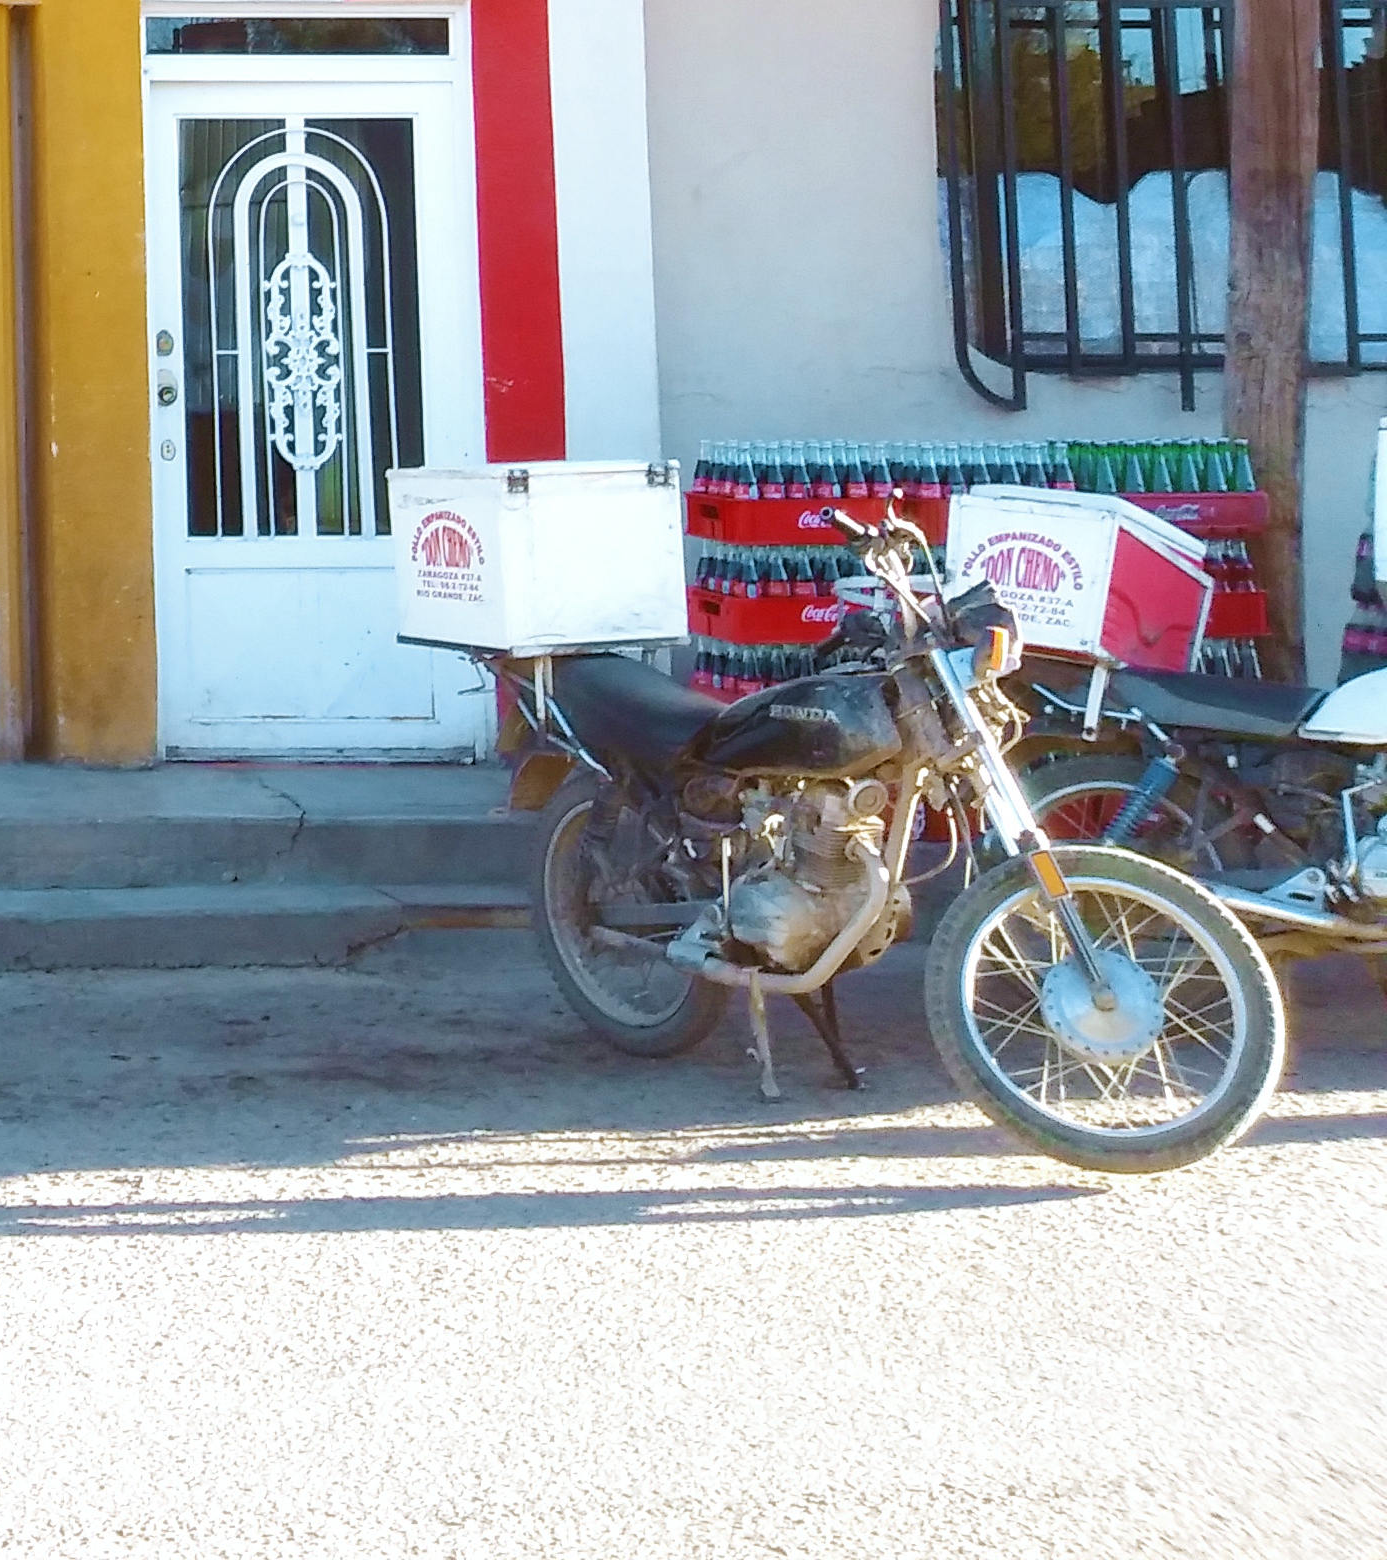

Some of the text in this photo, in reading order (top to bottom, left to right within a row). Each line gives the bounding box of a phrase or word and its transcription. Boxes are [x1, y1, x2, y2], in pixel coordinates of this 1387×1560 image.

[411, 526, 423, 562] POLLO
[466, 524, 485, 565] ESTILO
[417, 569, 459, 581] ZARAGOZA
[961, 531, 1084, 591] POLLO EMPANIZADO ESTILO
[768, 704, 841, 724] HONDA
